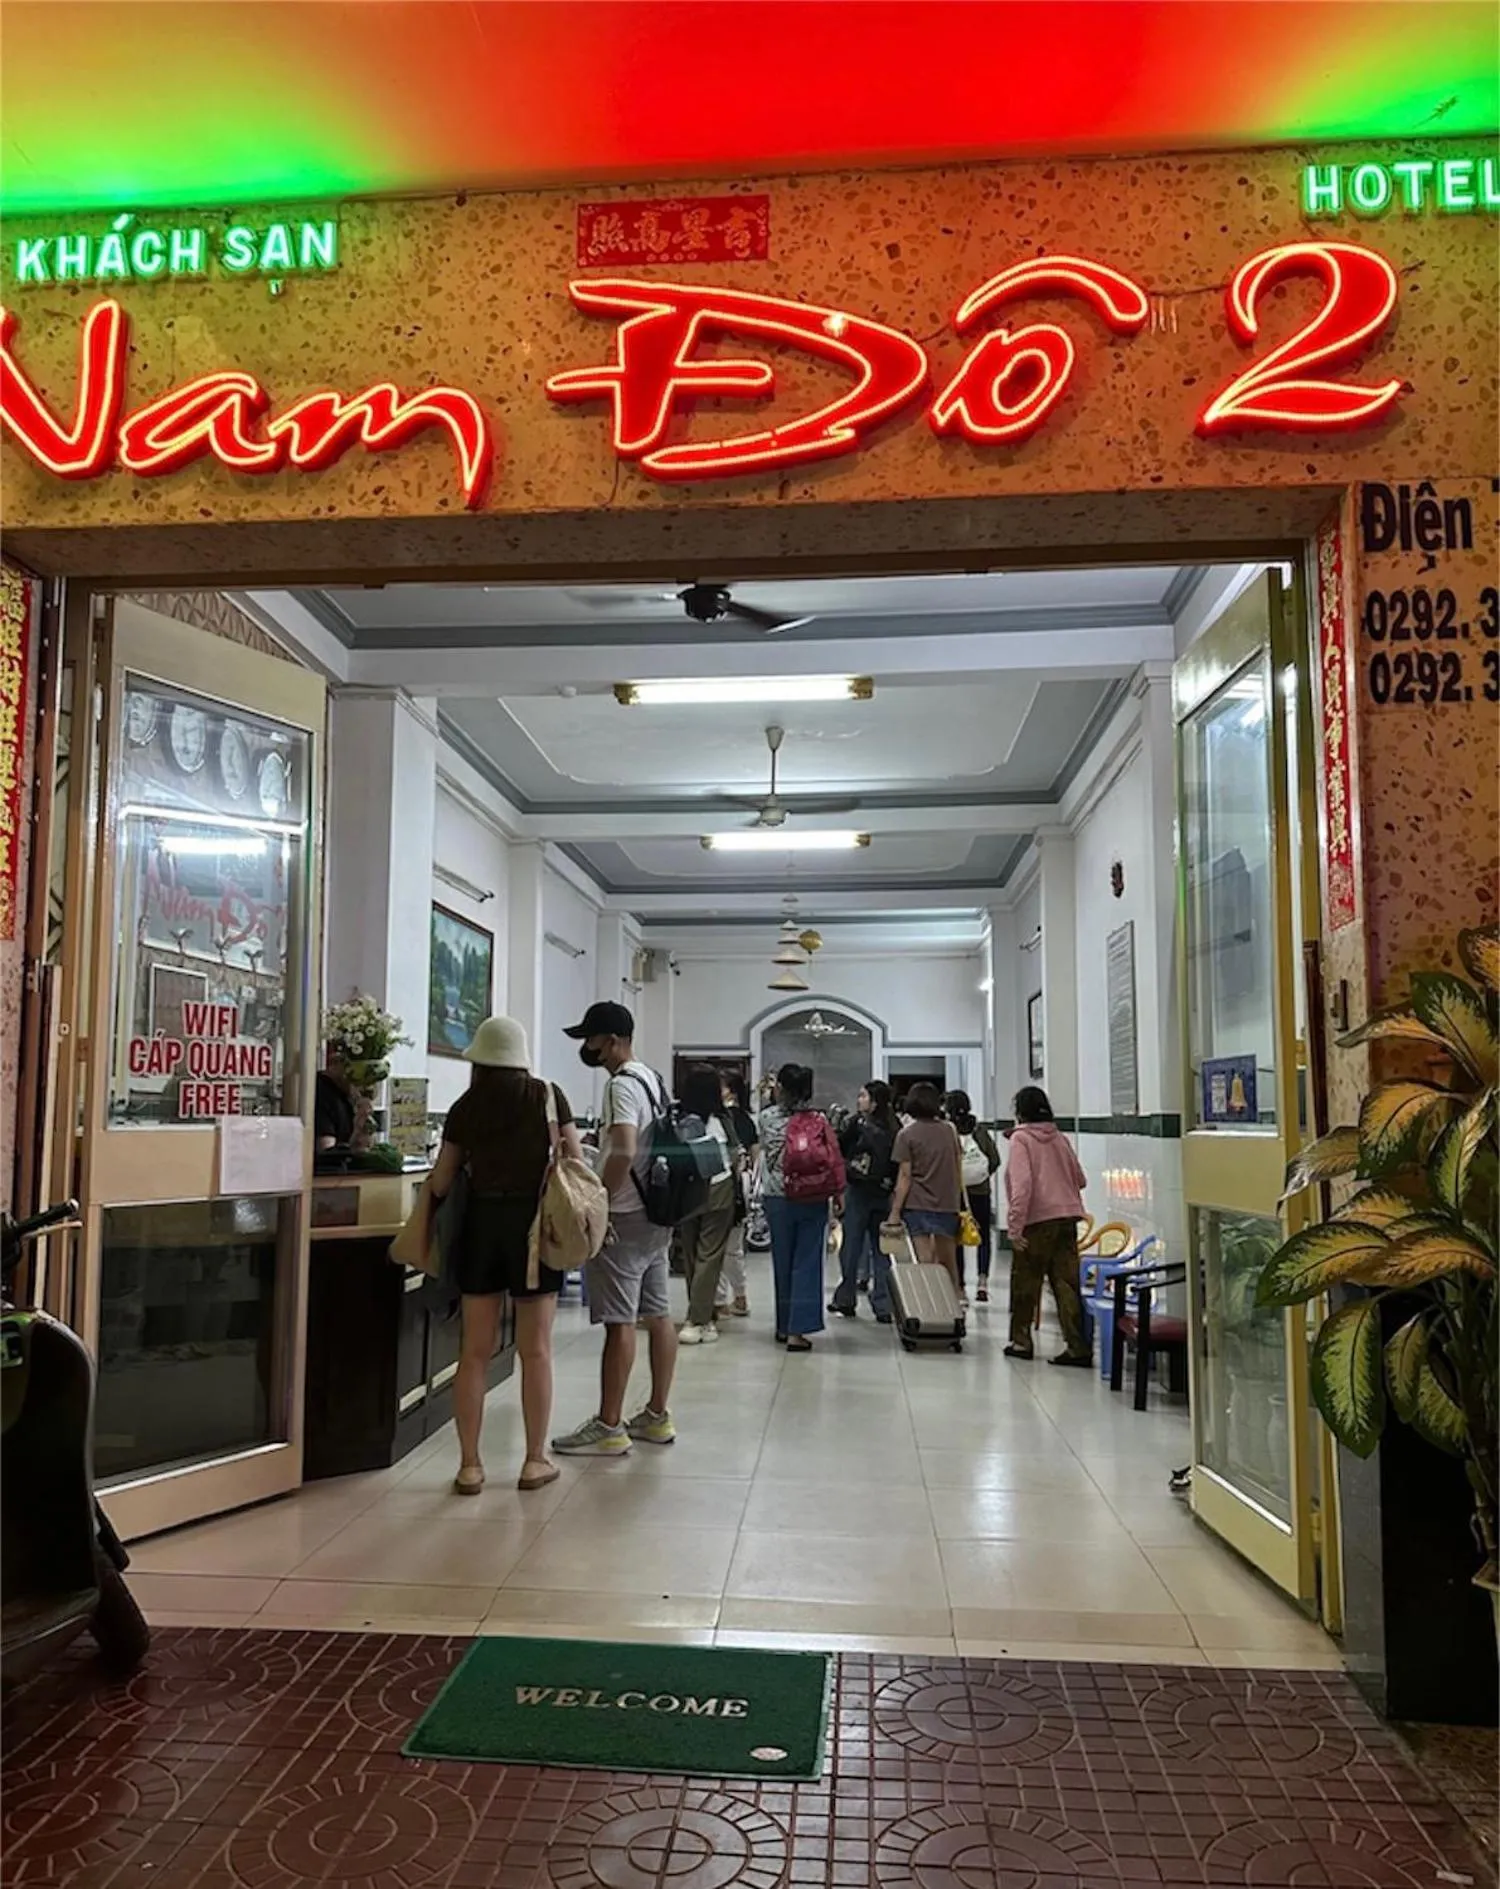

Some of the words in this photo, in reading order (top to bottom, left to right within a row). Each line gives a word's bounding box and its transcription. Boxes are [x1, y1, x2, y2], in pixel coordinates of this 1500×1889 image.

[1304, 158, 1500, 215] HOTEL
[16, 212, 206, 284] KHÁCH
[221, 220, 340, 296] SẠN
[547, 253, 1150, 480] Đô
[1194, 240, 1401, 429] 2
[1360, 481, 1473, 576] Điện
[182, 1001, 240, 1040] WIFI
[128, 1029, 183, 1076] CÁP
[188, 1039, 273, 1079] QUANG
[180, 1081, 242, 1117] FREE
[514, 1685, 749, 1718] WELCOME
